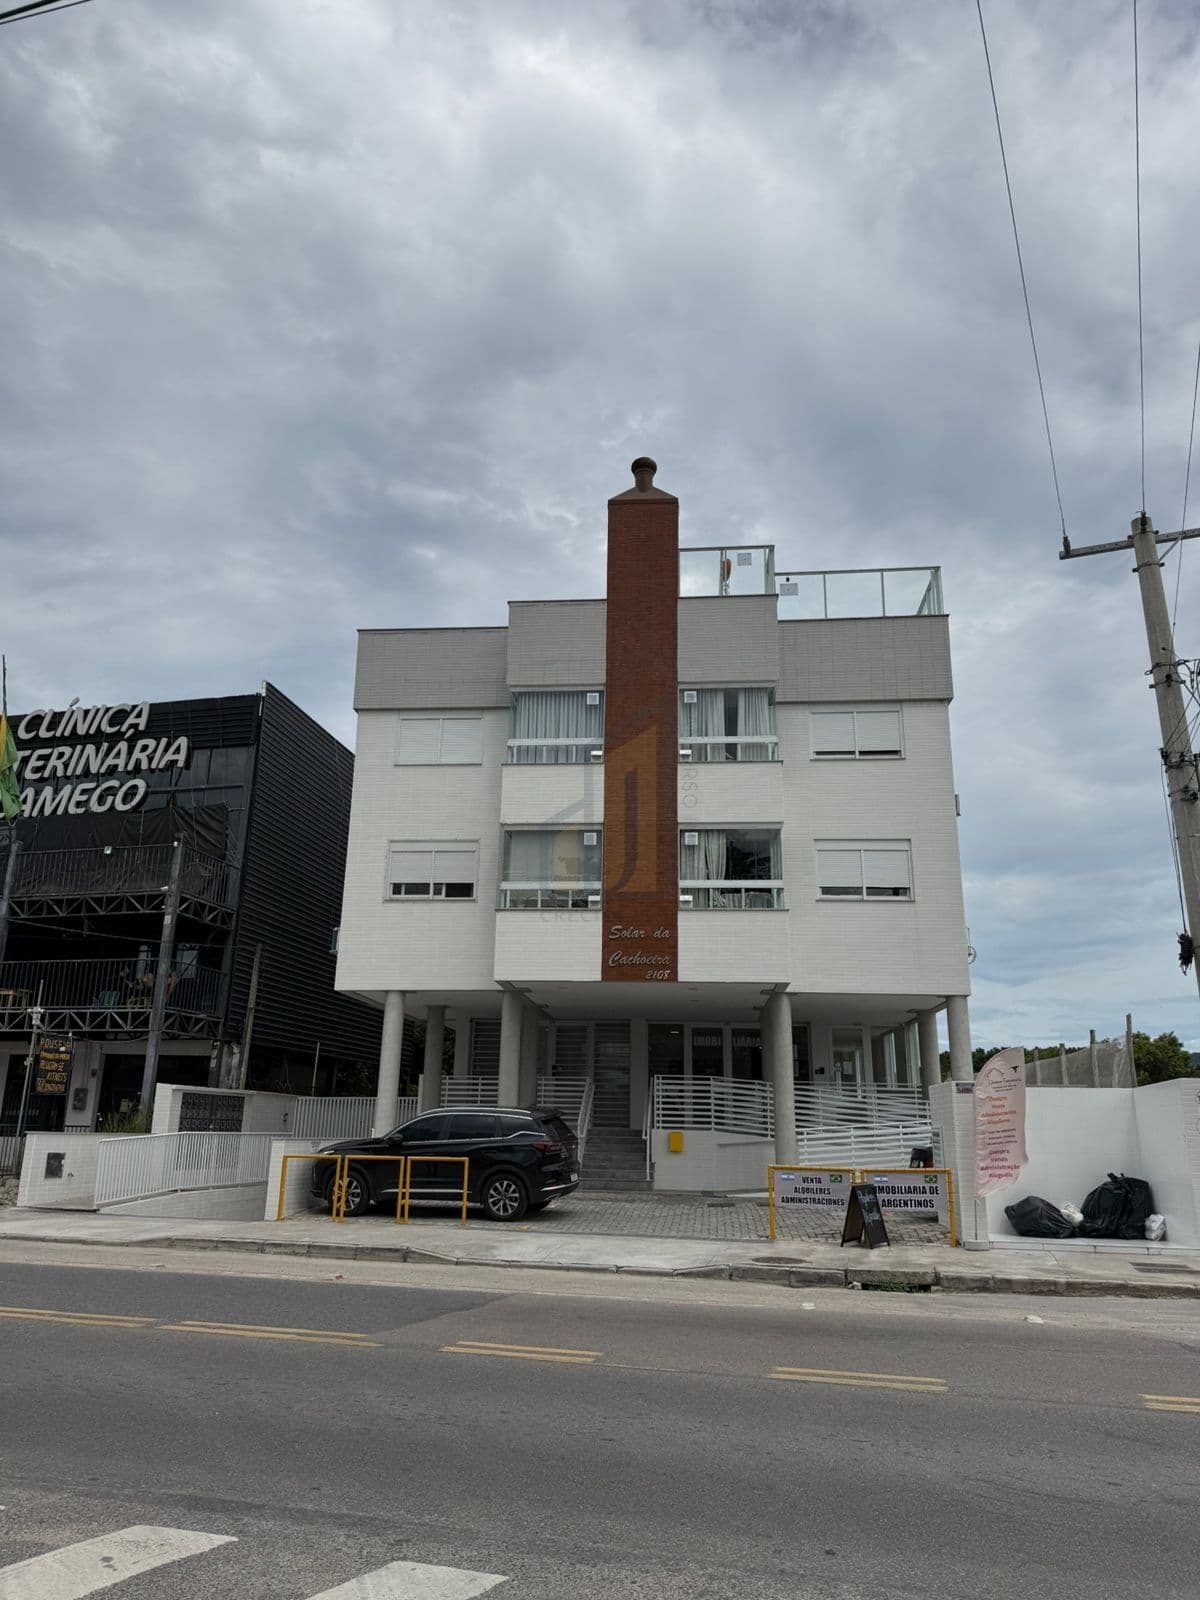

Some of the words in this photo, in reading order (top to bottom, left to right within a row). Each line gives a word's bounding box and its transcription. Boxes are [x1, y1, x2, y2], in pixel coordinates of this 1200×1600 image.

[17, 697, 150, 740] CLÍNICA
[16, 728, 188, 780] TERINÁRIA
[0, 778, 147, 818] AMEGO
[608, 925, 645, 939] Solar
[653, 926, 671, 939] da
[608, 950, 671, 967] Cachoeira
[645, 970, 670, 980] 2108
[801, 1176, 822, 1184] VENTA
[793, 1186, 831, 1195] ALQUILERES
[929, 1185, 940, 1195] DE
[781, 1196, 845, 1207] ADMINISTRACIONES
[881, 1198, 935, 1209] ARGENTINOS
